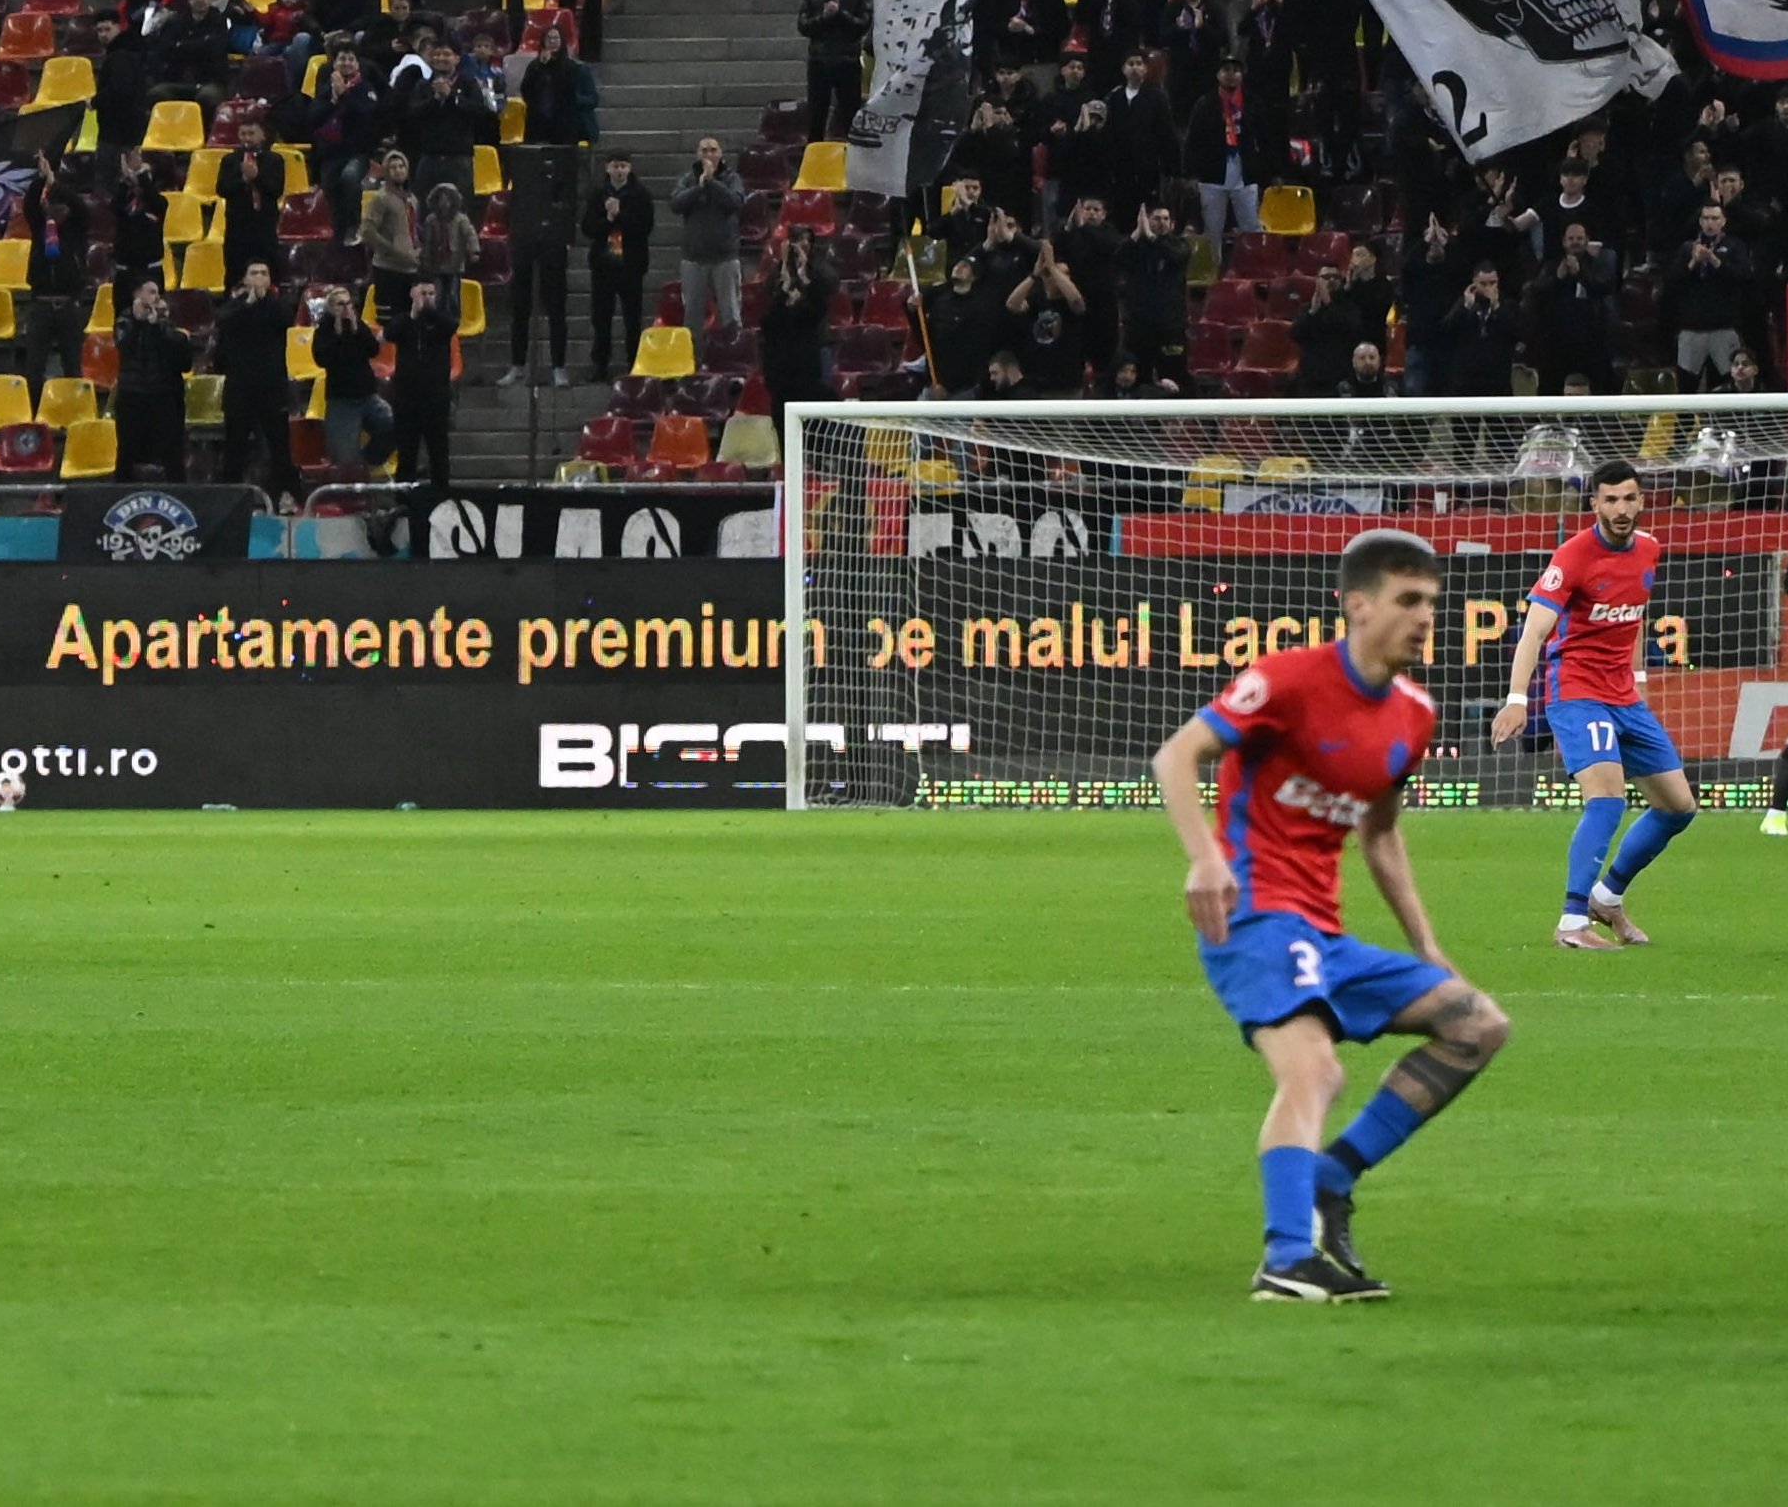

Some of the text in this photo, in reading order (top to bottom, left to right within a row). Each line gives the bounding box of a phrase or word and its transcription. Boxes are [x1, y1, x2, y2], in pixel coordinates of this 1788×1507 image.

[45, 603, 493, 685] Apartamente
[1586, 721, 1616, 752] 17
[1288, 940, 1322, 987] 3
